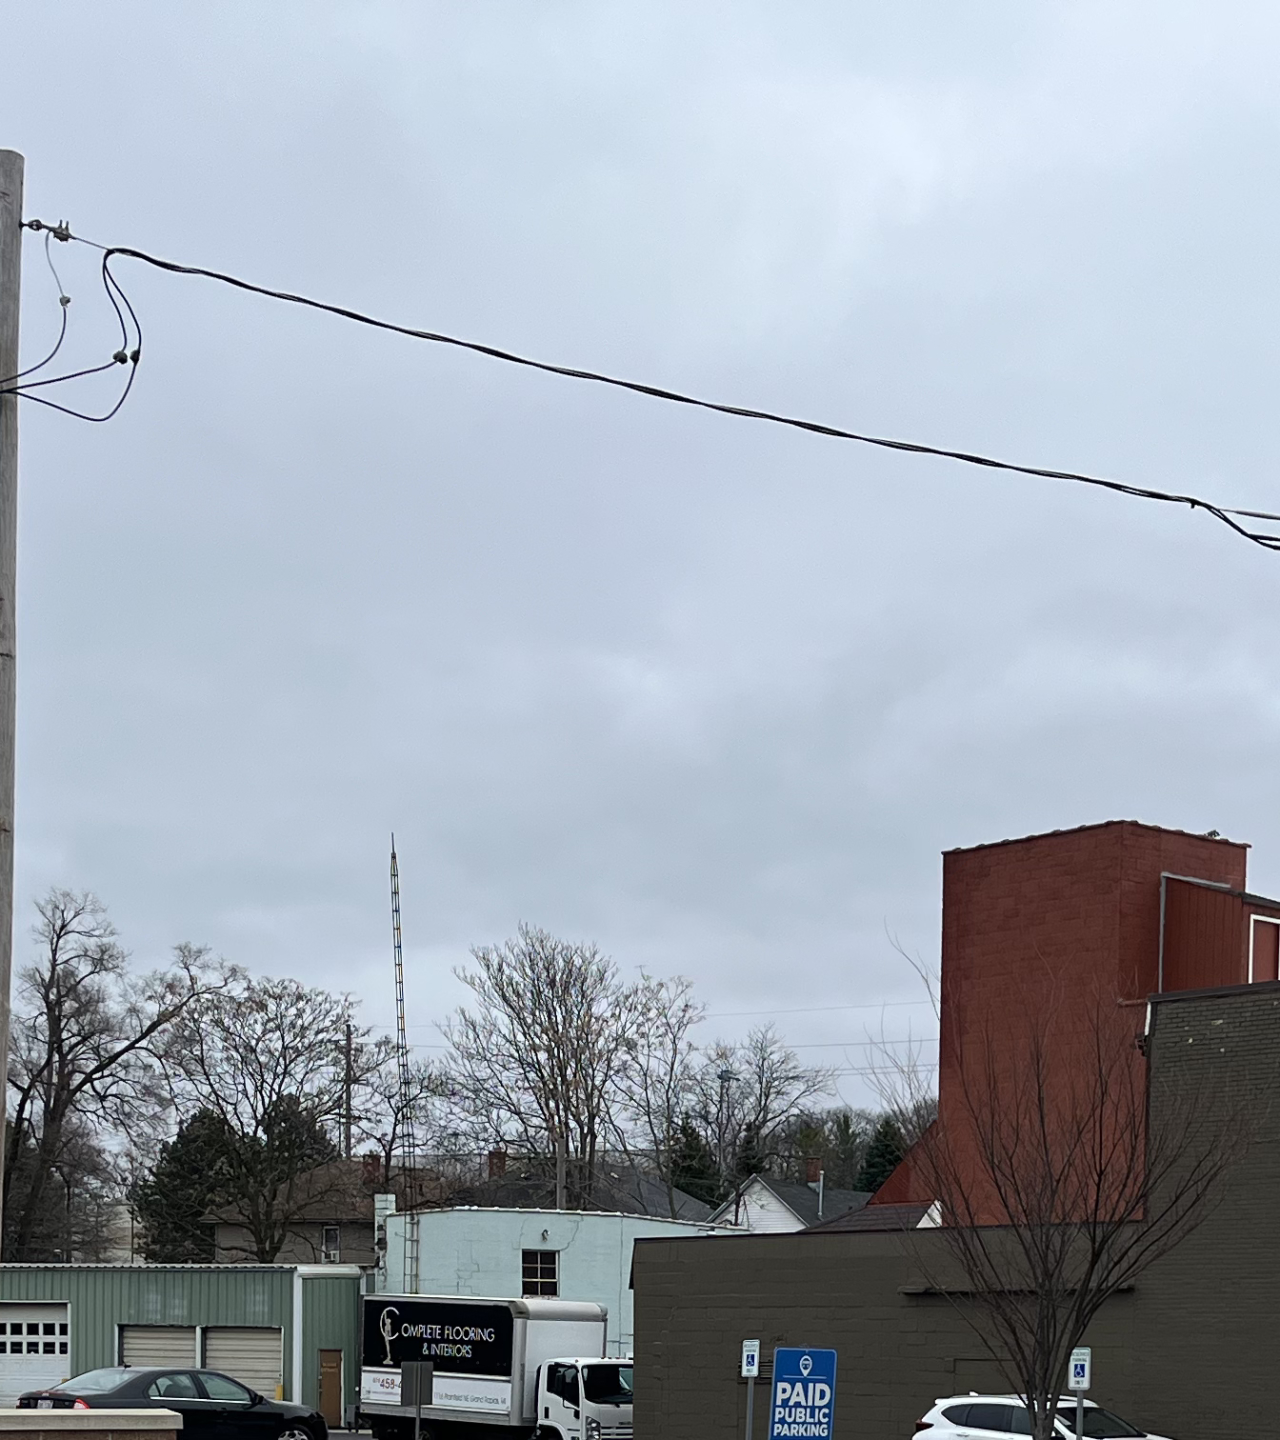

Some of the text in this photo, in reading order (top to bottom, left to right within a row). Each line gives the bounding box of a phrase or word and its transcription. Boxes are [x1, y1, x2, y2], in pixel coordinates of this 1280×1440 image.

[380, 1306, 495, 1342] COMPLETE FLOORING
[422, 1342, 472, 1357] & INTERIORS
[775, 1382, 831, 1406] PAID
[774, 1408, 829, 1423] PUBLIC
[773, 1424, 828, 1437] PARKING
